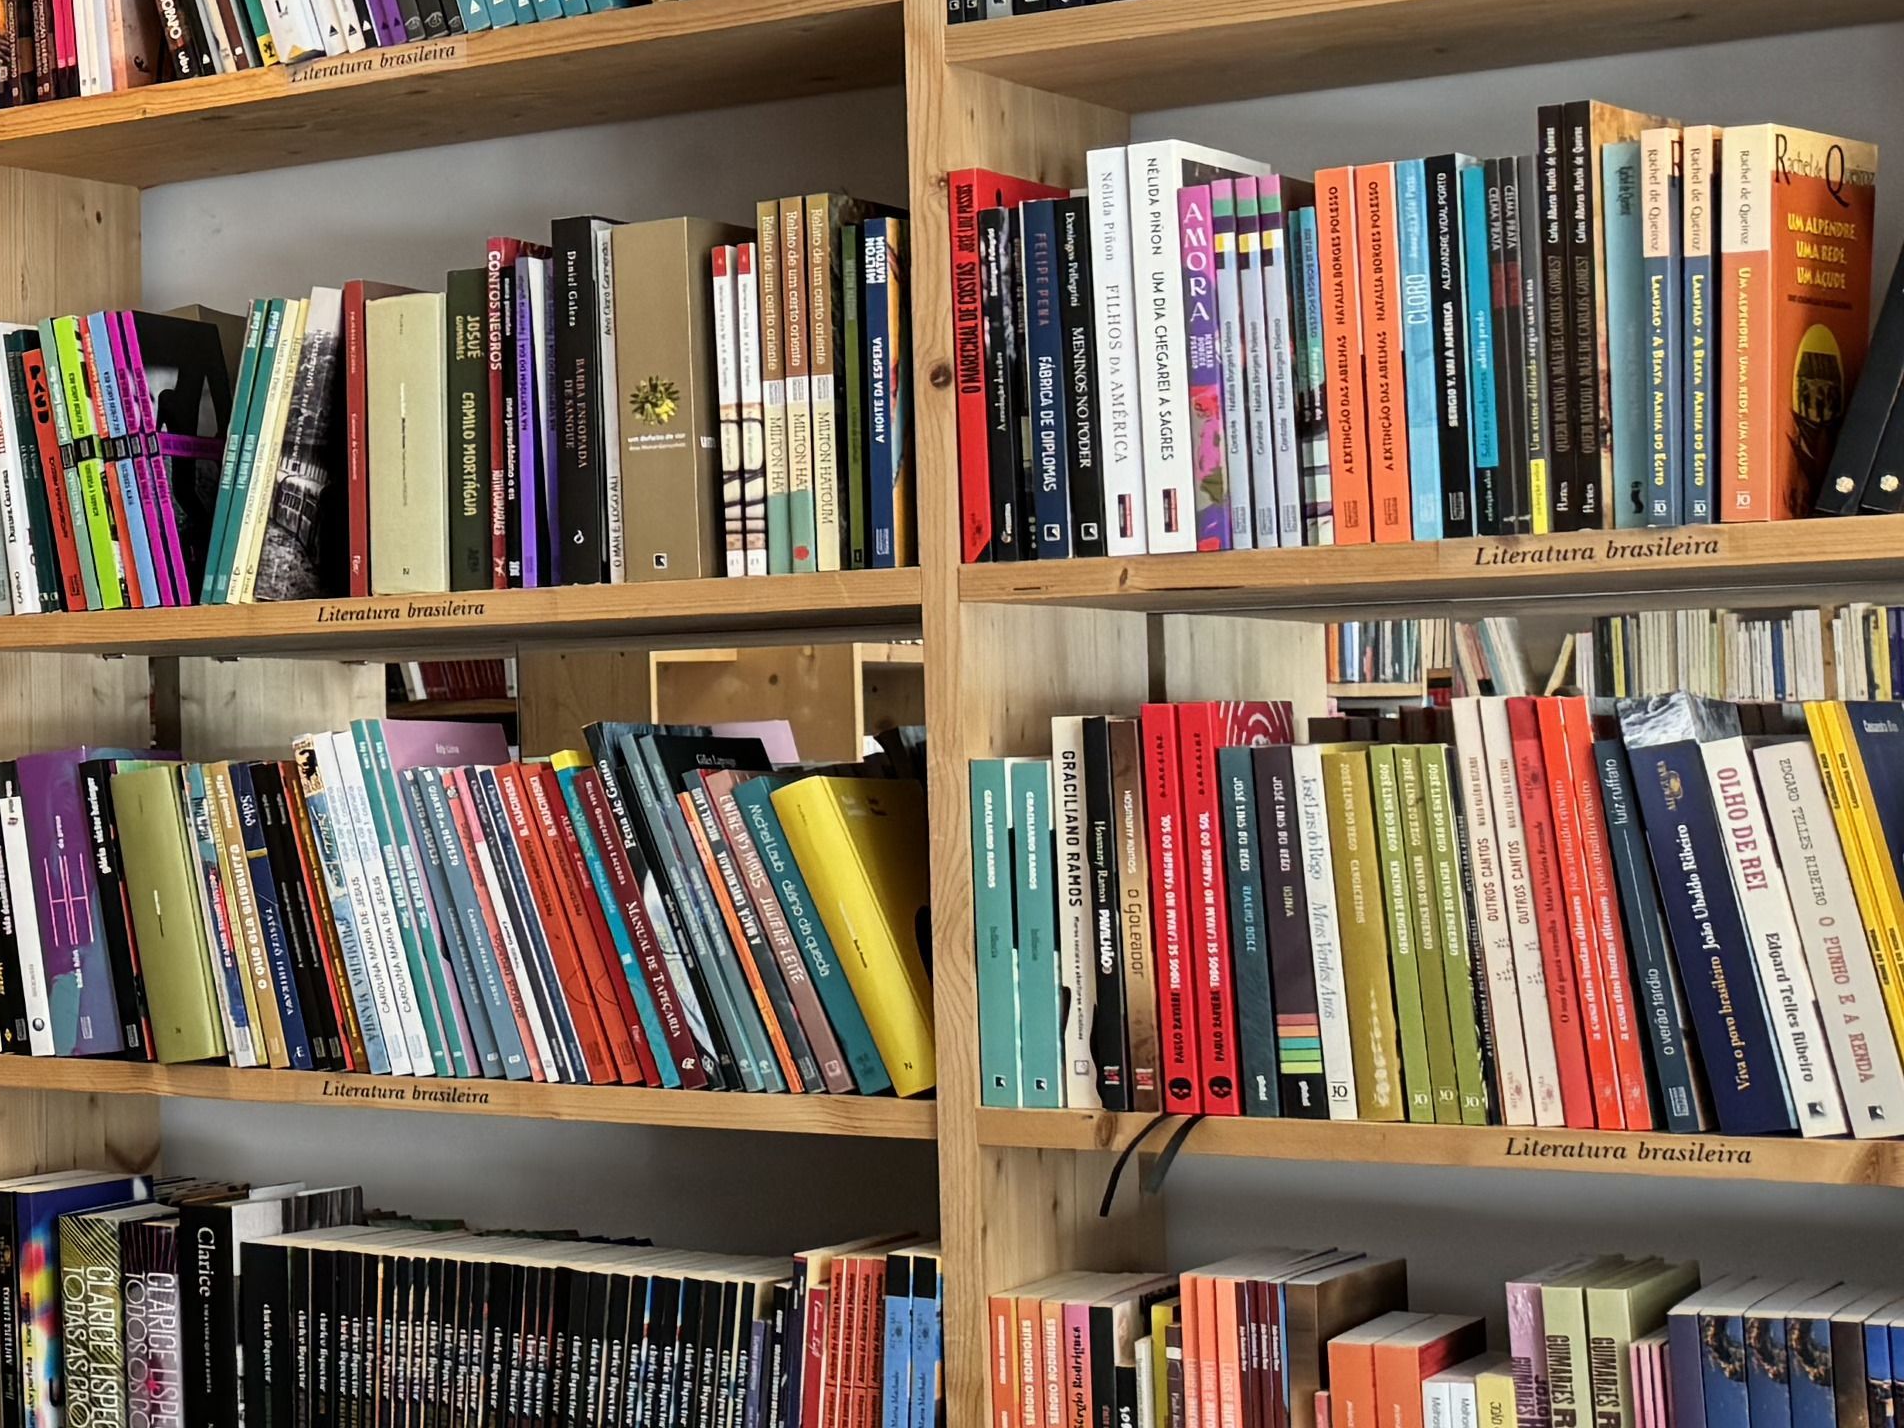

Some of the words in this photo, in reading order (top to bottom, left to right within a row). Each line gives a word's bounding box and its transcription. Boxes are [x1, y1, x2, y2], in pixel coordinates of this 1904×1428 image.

[290, 56, 373, 83] Literatura
[379, 42, 457, 70] brasileira
[1147, 157, 1159, 207] NÉLIDA
[1150, 211, 1162, 256] PIÑON
[1151, 271, 1164, 292] UM
[1183, 203, 1209, 323] AMORA
[1817, 270, 1846, 290] AÇUDE
[1153, 297, 1165, 322] DIA
[1407, 273, 1427, 324] CLORO
[1072, 327, 1086, 387] MENINOS
[1154, 325, 1169, 392] CHEGAREI
[1038, 356, 1054, 411] FÁBRICA
[462, 391, 476, 449] CAMILO
[817, 412, 830, 461] MILTON
[1077, 411, 1091, 469] PODER
[1161, 409, 1174, 461] SAGRES
[463, 452, 476, 517] MORTÁGUA
[1042, 431, 1057, 492] DIPLOMAS
[1474, 545, 1595, 566] Literatura
[1606, 538, 1720, 559] brasileira
[316, 602, 400, 624] Literatura
[407, 597, 486, 619] brasileira
[1717, 768, 1747, 822] OLHO
[1734, 825, 1758, 853] DE
[1745, 856, 1768, 892] REI
[1766, 932, 1788, 983] Edgard
[1791, 1023, 1813, 1083] Ribeiro
[322, 1078, 405, 1102] Literatura
[412, 1084, 490, 1106] brasileira
[1505, 1137, 1627, 1160] Literatura
[1638, 1141, 1752, 1164] brasileira
[197, 1226, 216, 1297] Clarice
[86, 1266, 117, 1355] CLARICE
[125, 1272, 148, 1354] TODOS
[146, 1272, 177, 1360] CLARICE
